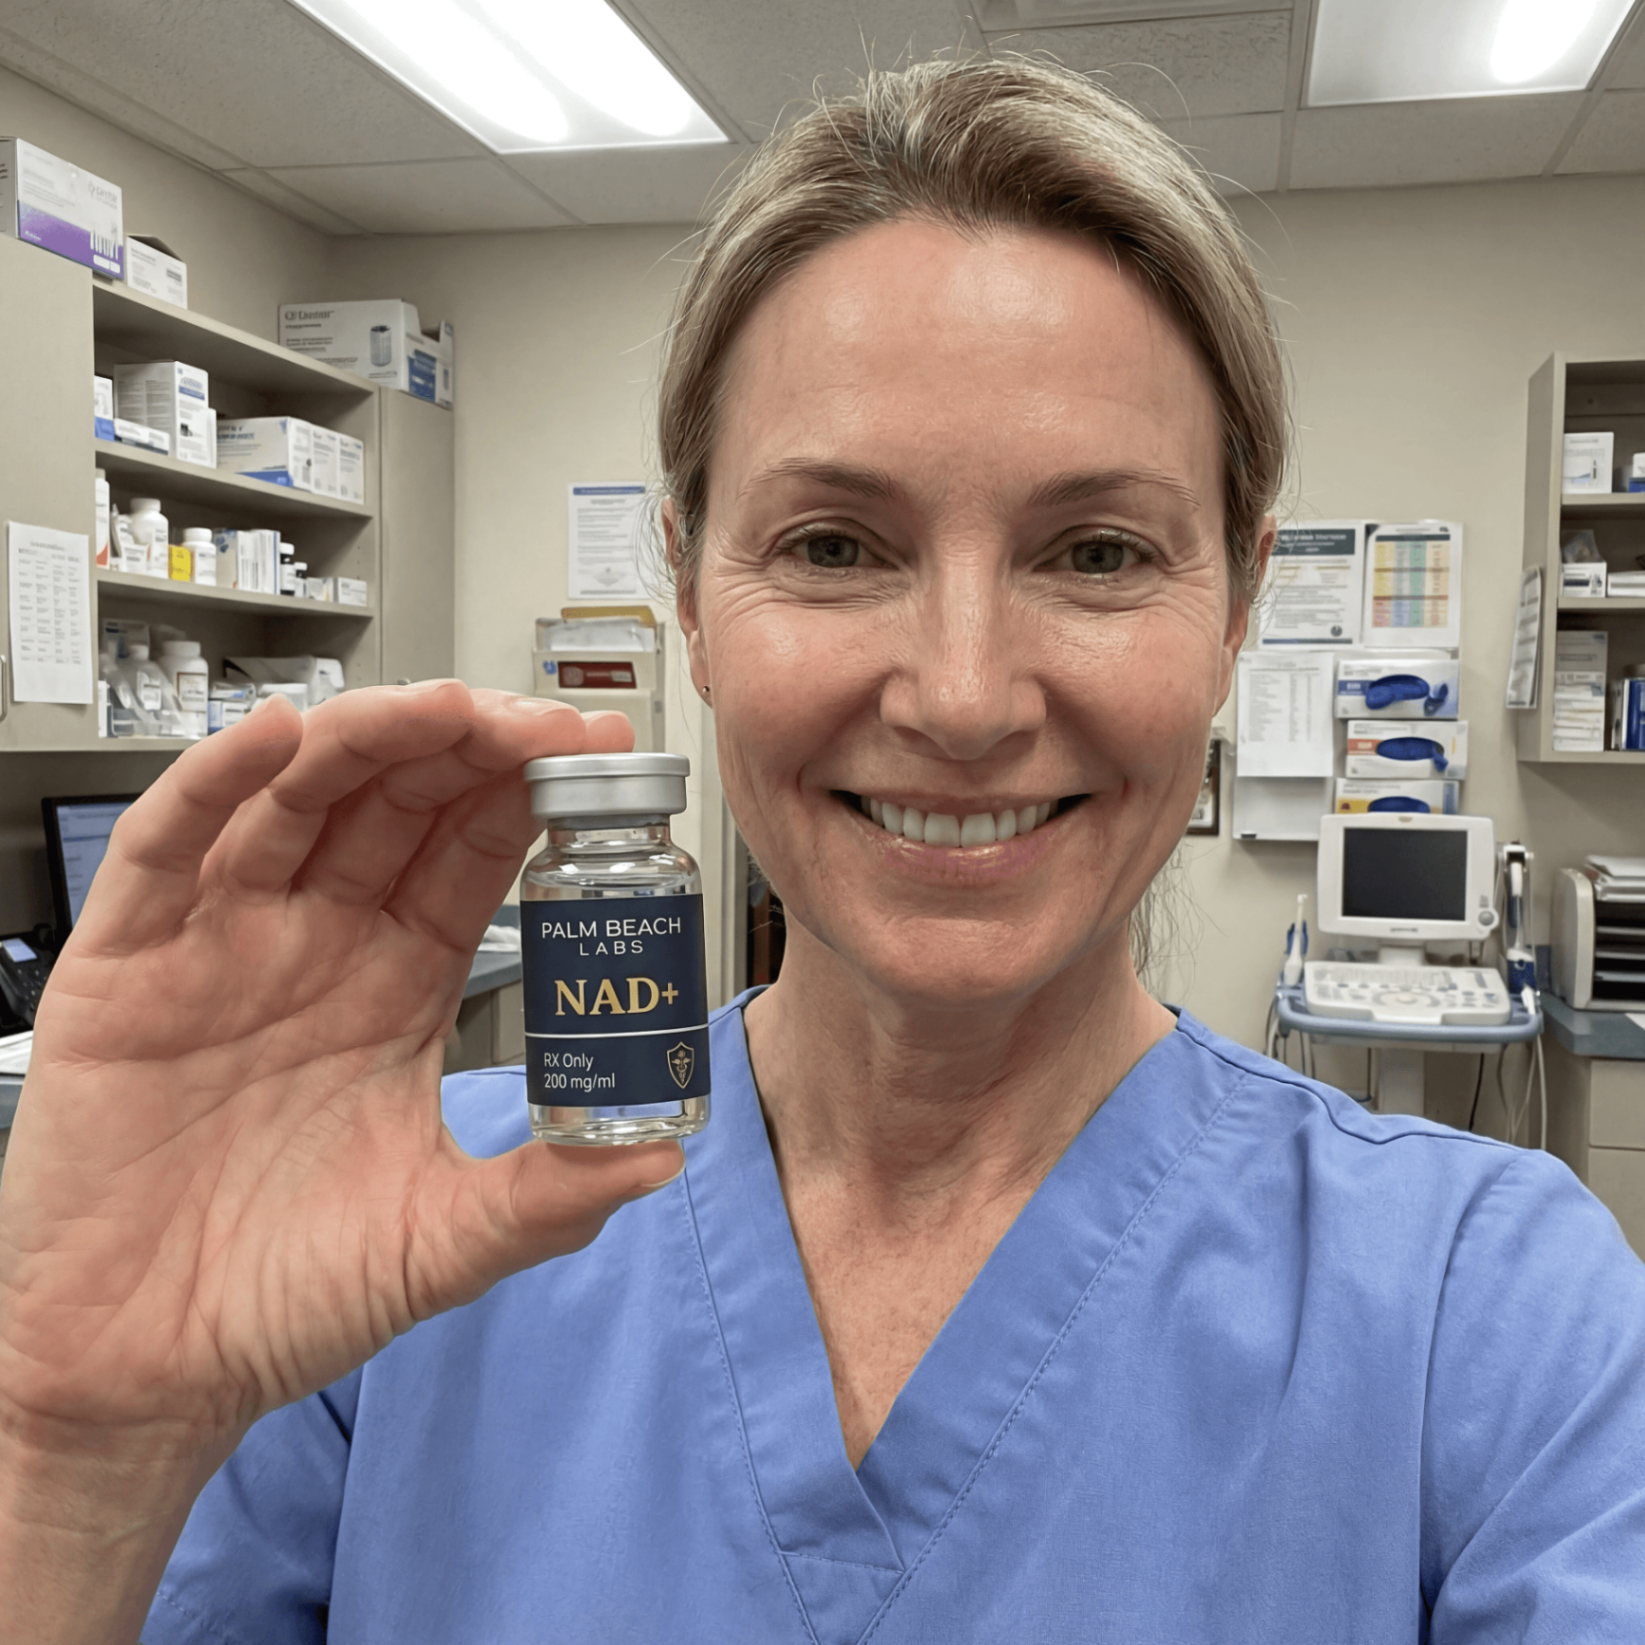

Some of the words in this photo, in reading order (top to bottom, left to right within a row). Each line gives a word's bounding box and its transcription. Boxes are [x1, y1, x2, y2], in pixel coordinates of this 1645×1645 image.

[541, 920, 598, 939] PALM
[605, 916, 682, 938] BEACH
[579, 940, 644, 957] LABS
[554, 976, 679, 1016] NAD+
[543, 1052, 560, 1068] RX
[562, 1052, 594, 1072] Only
[543, 1073, 568, 1089] 200
[570, 1072, 616, 1093] mg/ml
